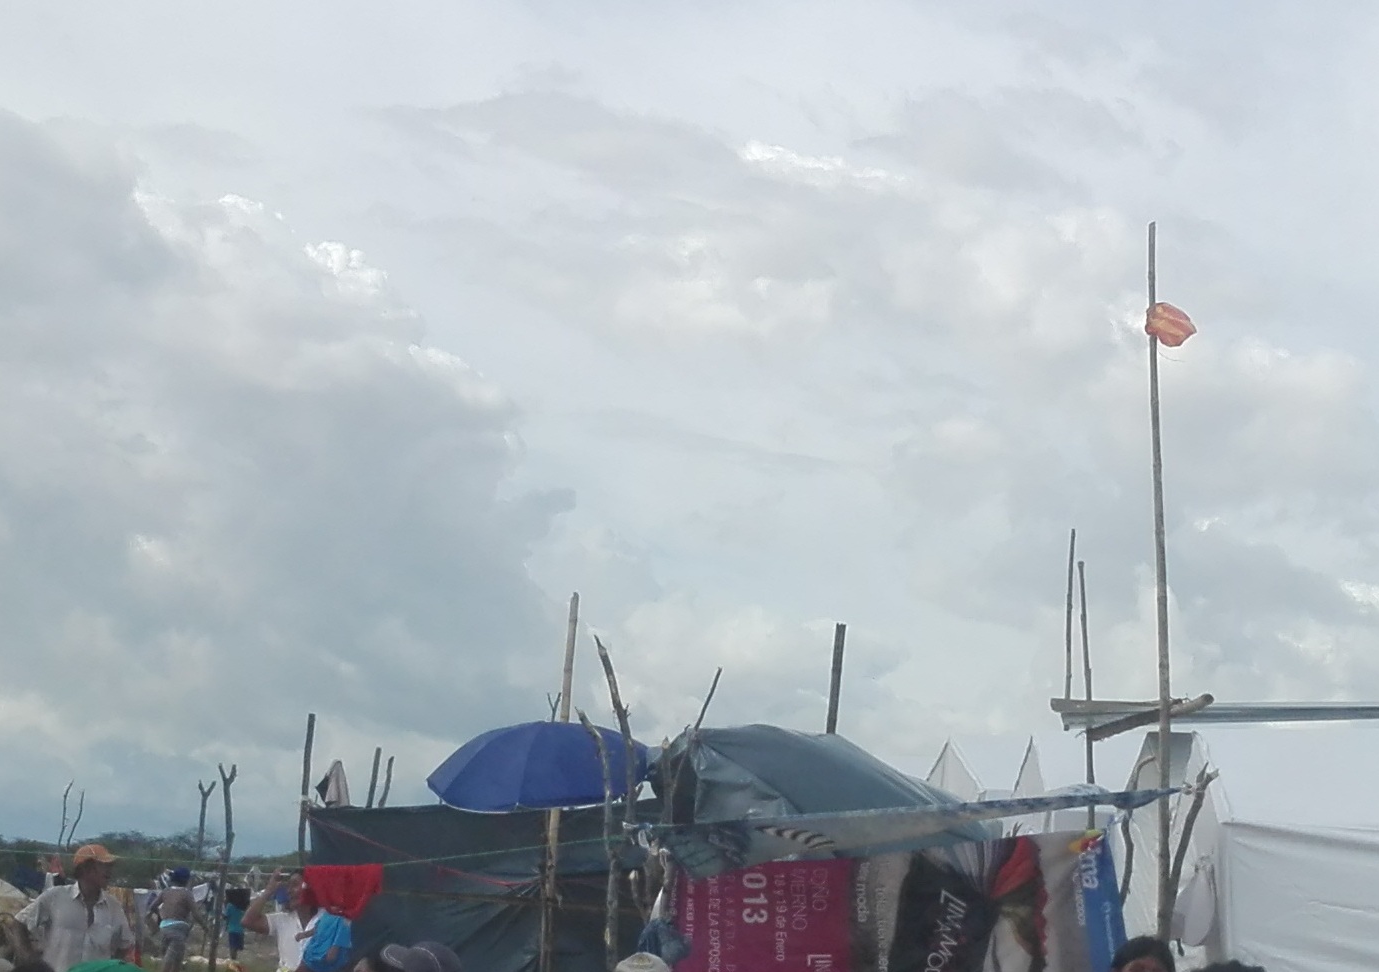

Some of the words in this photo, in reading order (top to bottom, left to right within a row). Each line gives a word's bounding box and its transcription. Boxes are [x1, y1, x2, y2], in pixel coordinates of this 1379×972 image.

[708, 897, 721, 911] DE
[742, 872, 769, 924] 013
[856, 883, 869, 922] moda
[776, 899, 788, 914] 19
[708, 912, 720, 926] LA
[775, 915, 786, 929] de
[775, 931, 788, 962] Enero
